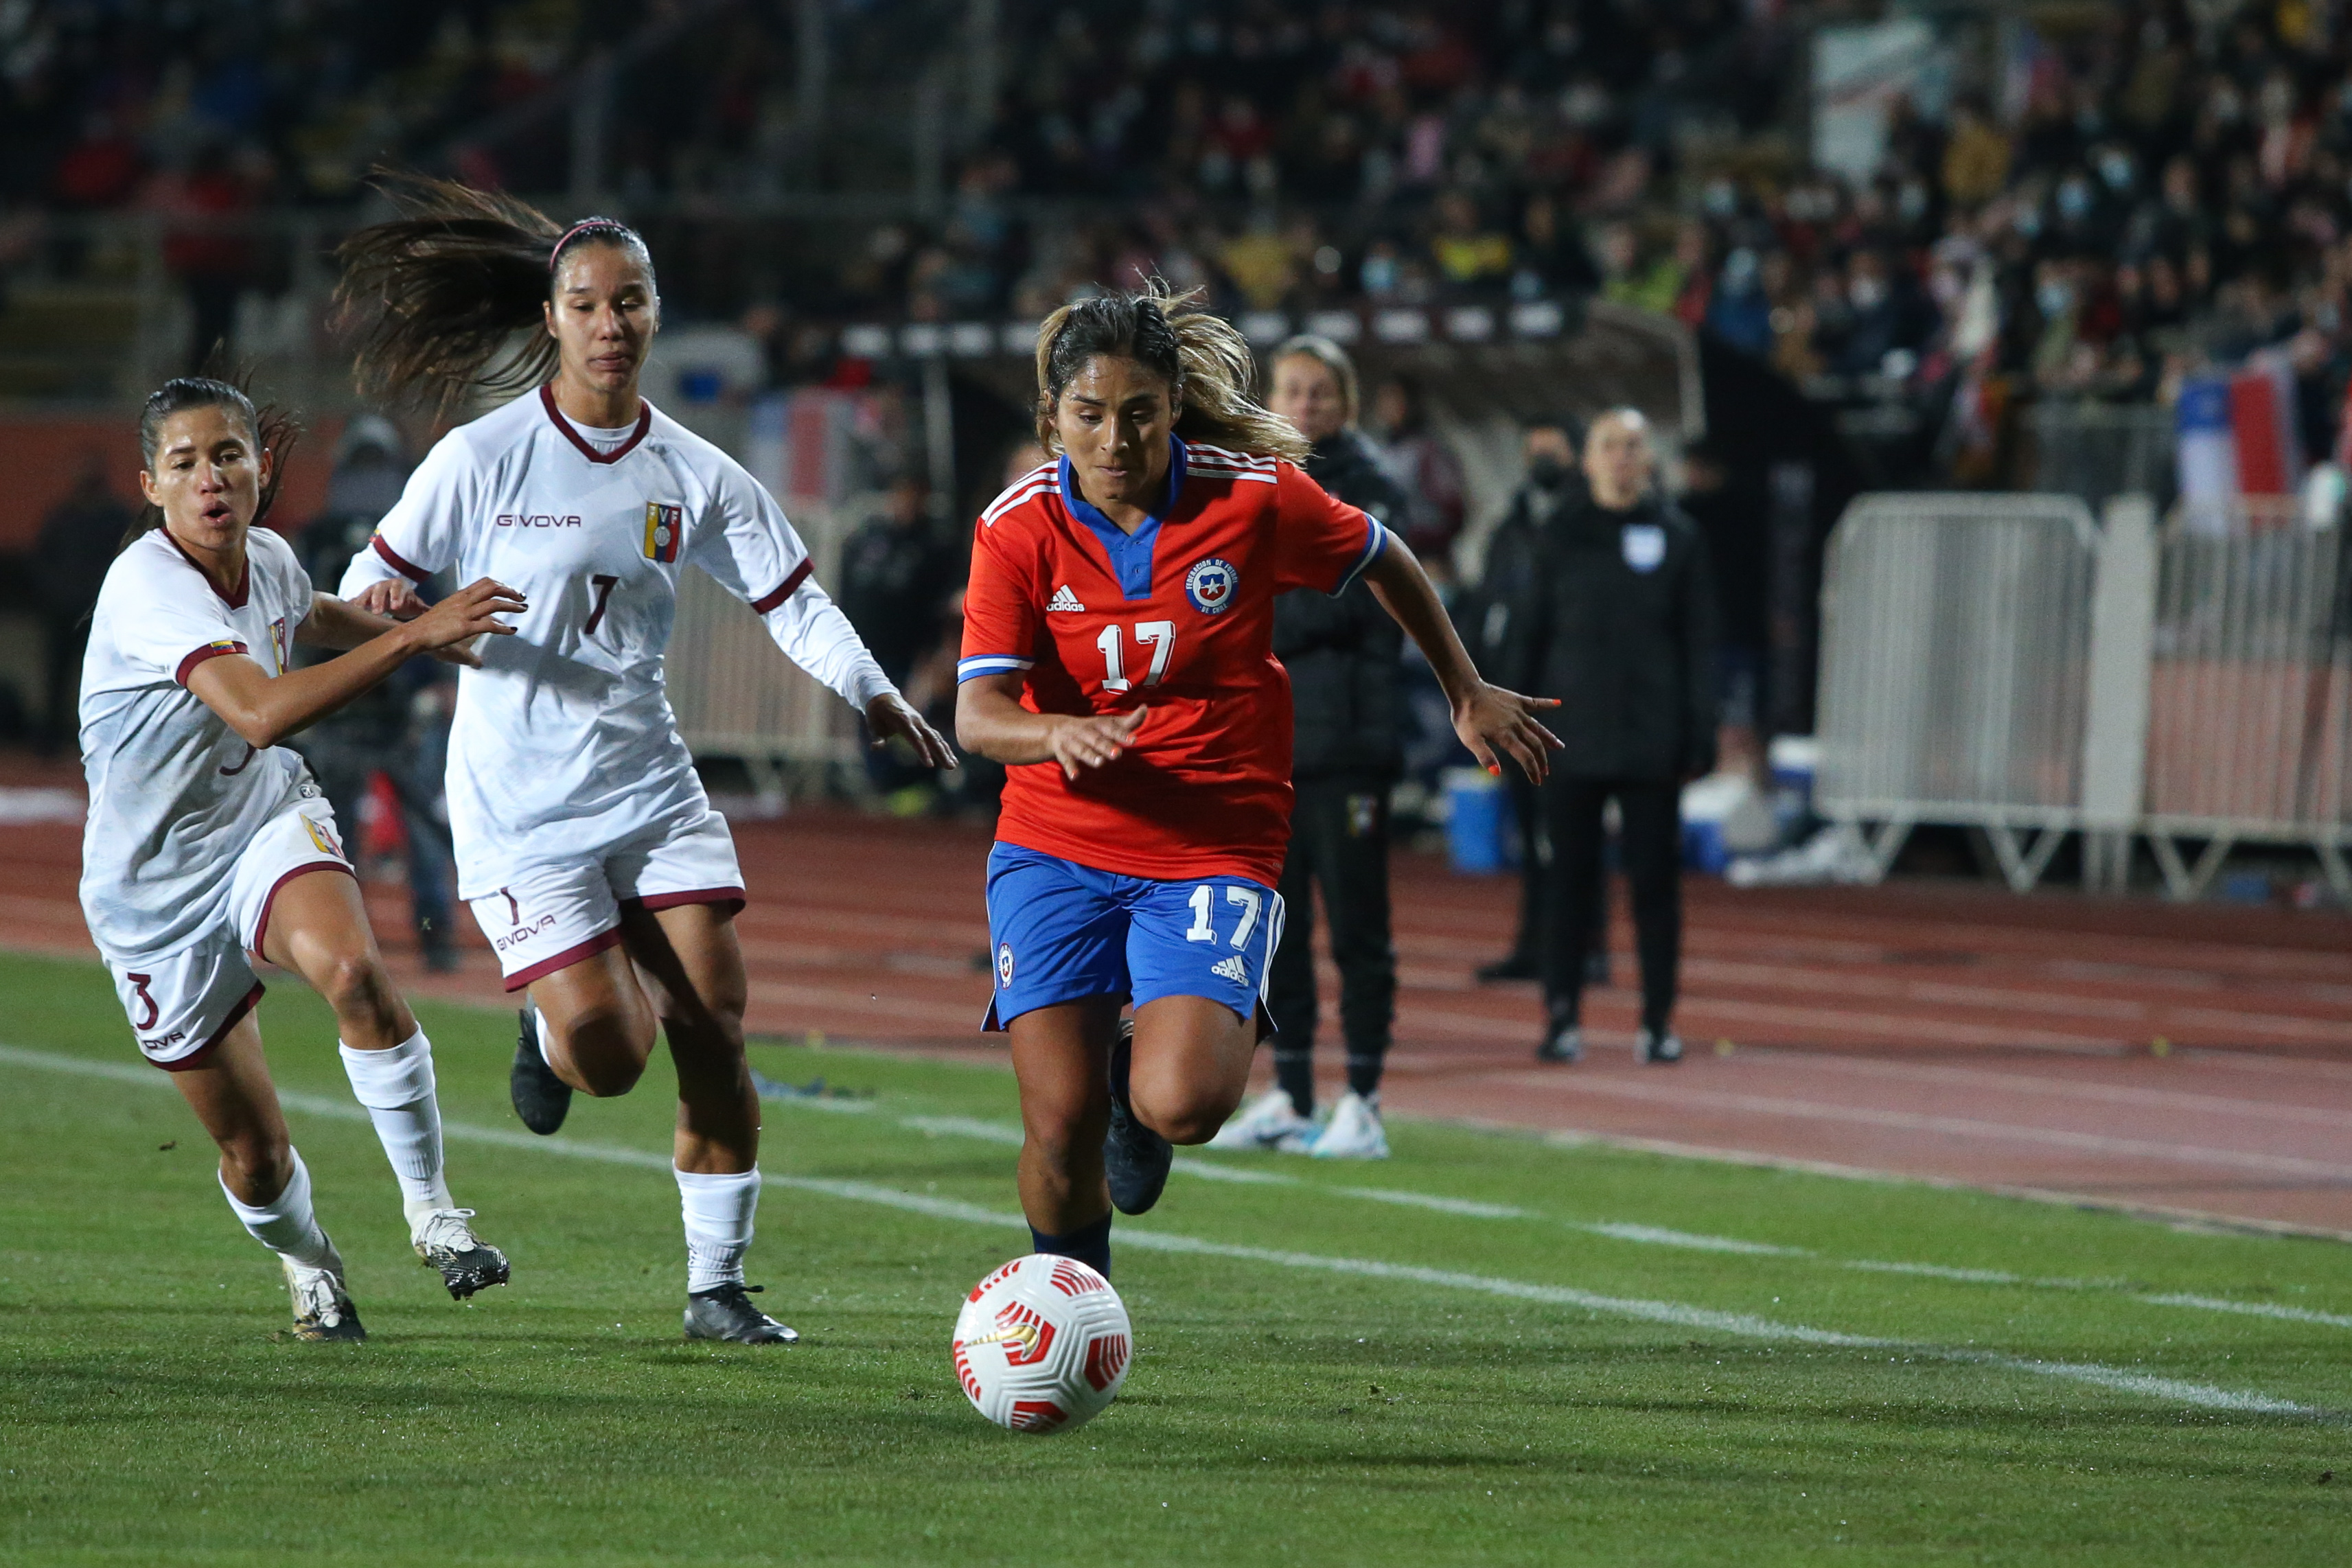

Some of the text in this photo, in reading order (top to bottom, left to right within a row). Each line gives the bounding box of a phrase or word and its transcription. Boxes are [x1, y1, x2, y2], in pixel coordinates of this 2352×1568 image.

[497, 515, 581, 527] GIVOVA
[584, 574, 619, 634] 7
[1046, 600, 1085, 612] adidas
[1096, 620, 1176, 695] 17
[496, 914, 556, 951] GIVOVA
[1186, 885, 1262, 952] 17
[1211, 965, 1249, 987] adidas
[127, 972, 159, 1030] 3
